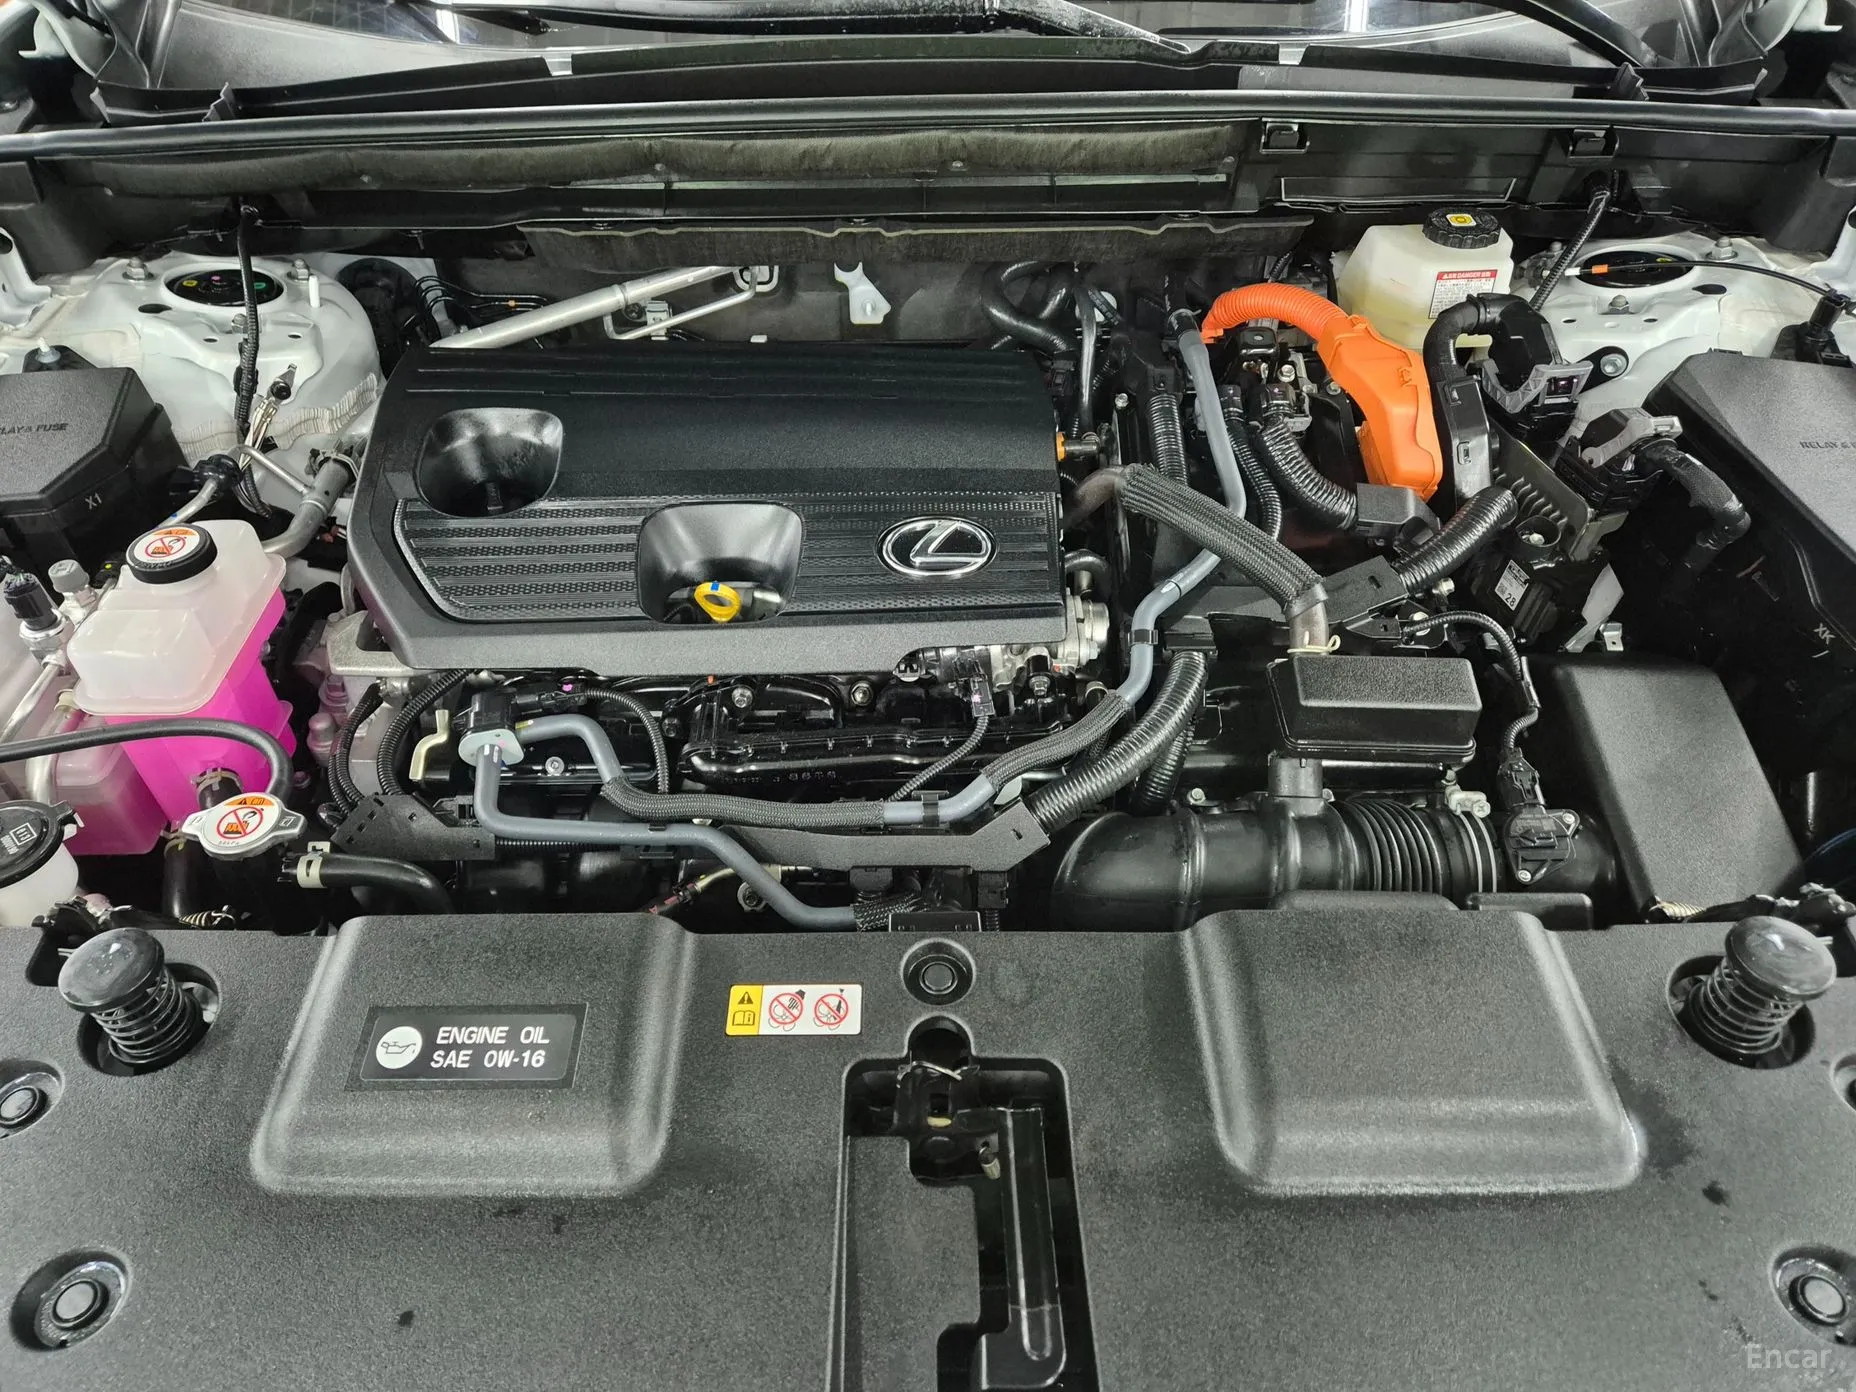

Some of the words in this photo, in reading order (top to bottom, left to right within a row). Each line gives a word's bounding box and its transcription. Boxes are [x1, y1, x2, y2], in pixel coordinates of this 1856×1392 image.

[36, 422, 69, 432] FUSE
[1799, 440, 1838, 449] RELAY
[1504, 592, 1517, 607] 28
[436, 1026, 509, 1045] ENGINE
[519, 1026, 550, 1044] OIL
[430, 1049, 473, 1068] SAE
[483, 1049, 546, 1068] 0W-16
